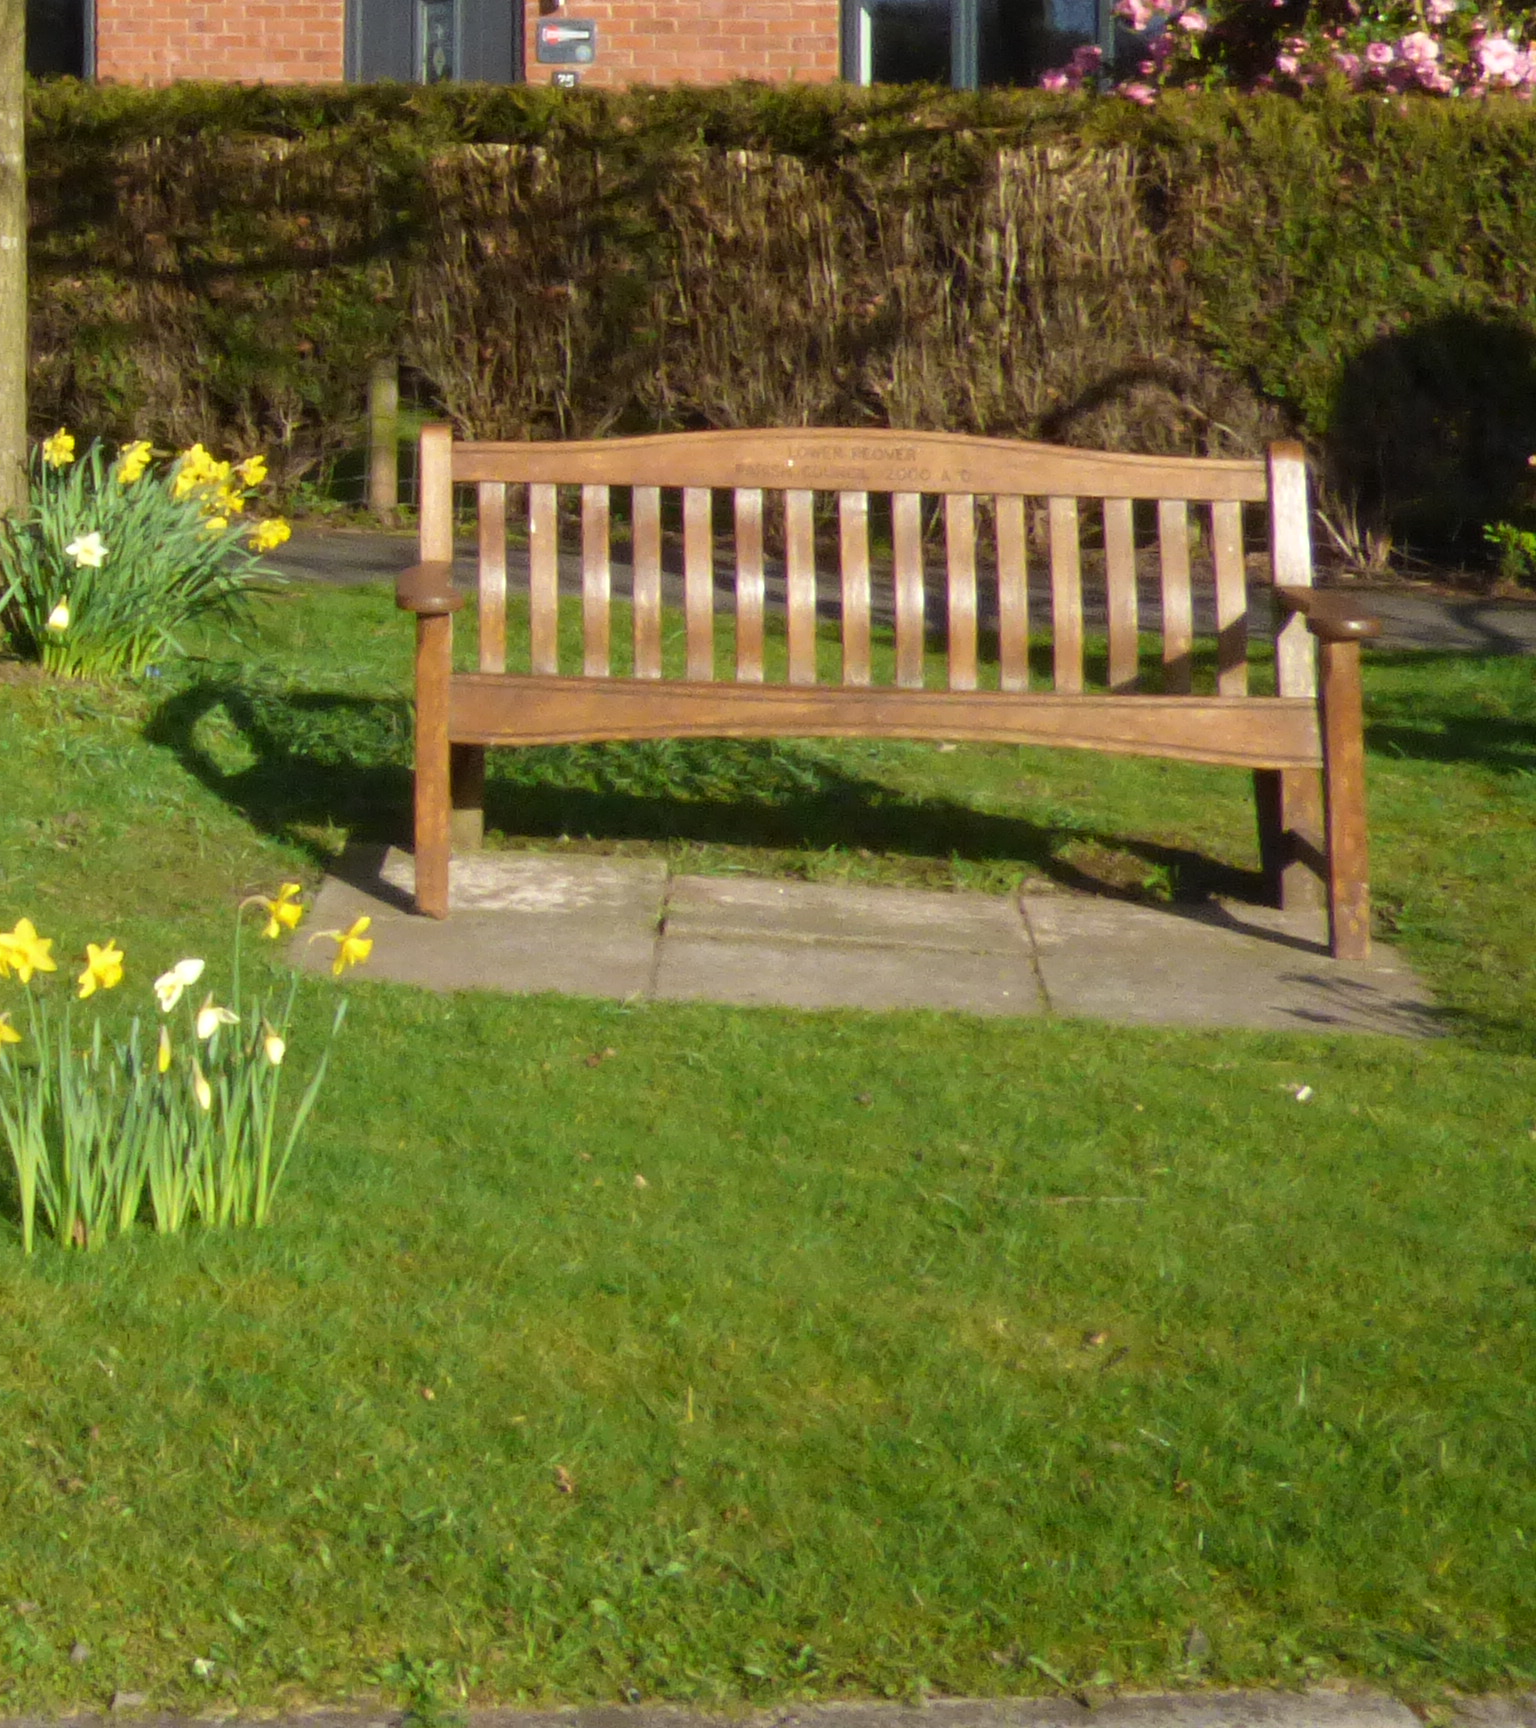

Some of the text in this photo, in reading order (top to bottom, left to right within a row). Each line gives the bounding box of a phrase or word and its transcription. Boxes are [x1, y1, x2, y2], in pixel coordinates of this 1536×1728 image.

[787, 445, 917, 462] LOWER PEOVER
[885, 466, 931, 482] 2000
